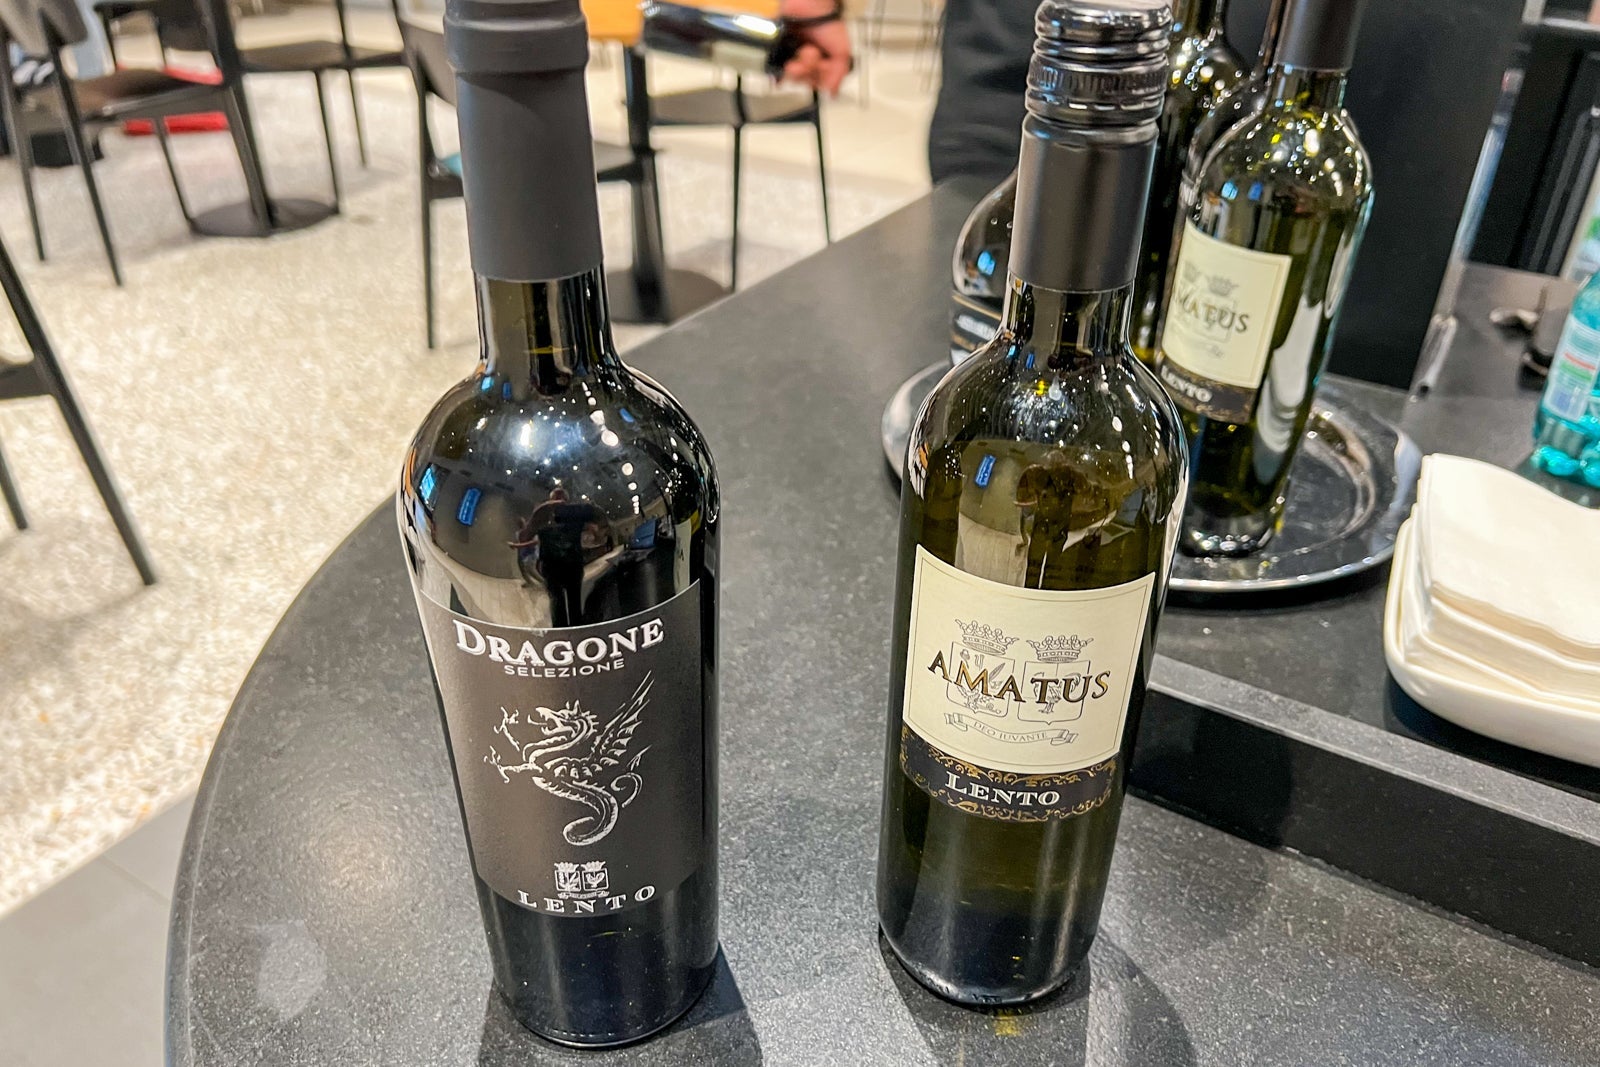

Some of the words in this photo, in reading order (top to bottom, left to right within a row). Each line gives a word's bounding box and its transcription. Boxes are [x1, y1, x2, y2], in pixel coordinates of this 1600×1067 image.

[452, 618, 664, 667] DRAGONE
[503, 658, 625, 678] SELEZIONE
[927, 650, 1111, 705] AMATUS
[945, 770, 1060, 806] LENTO
[517, 885, 656, 914] LENTO
